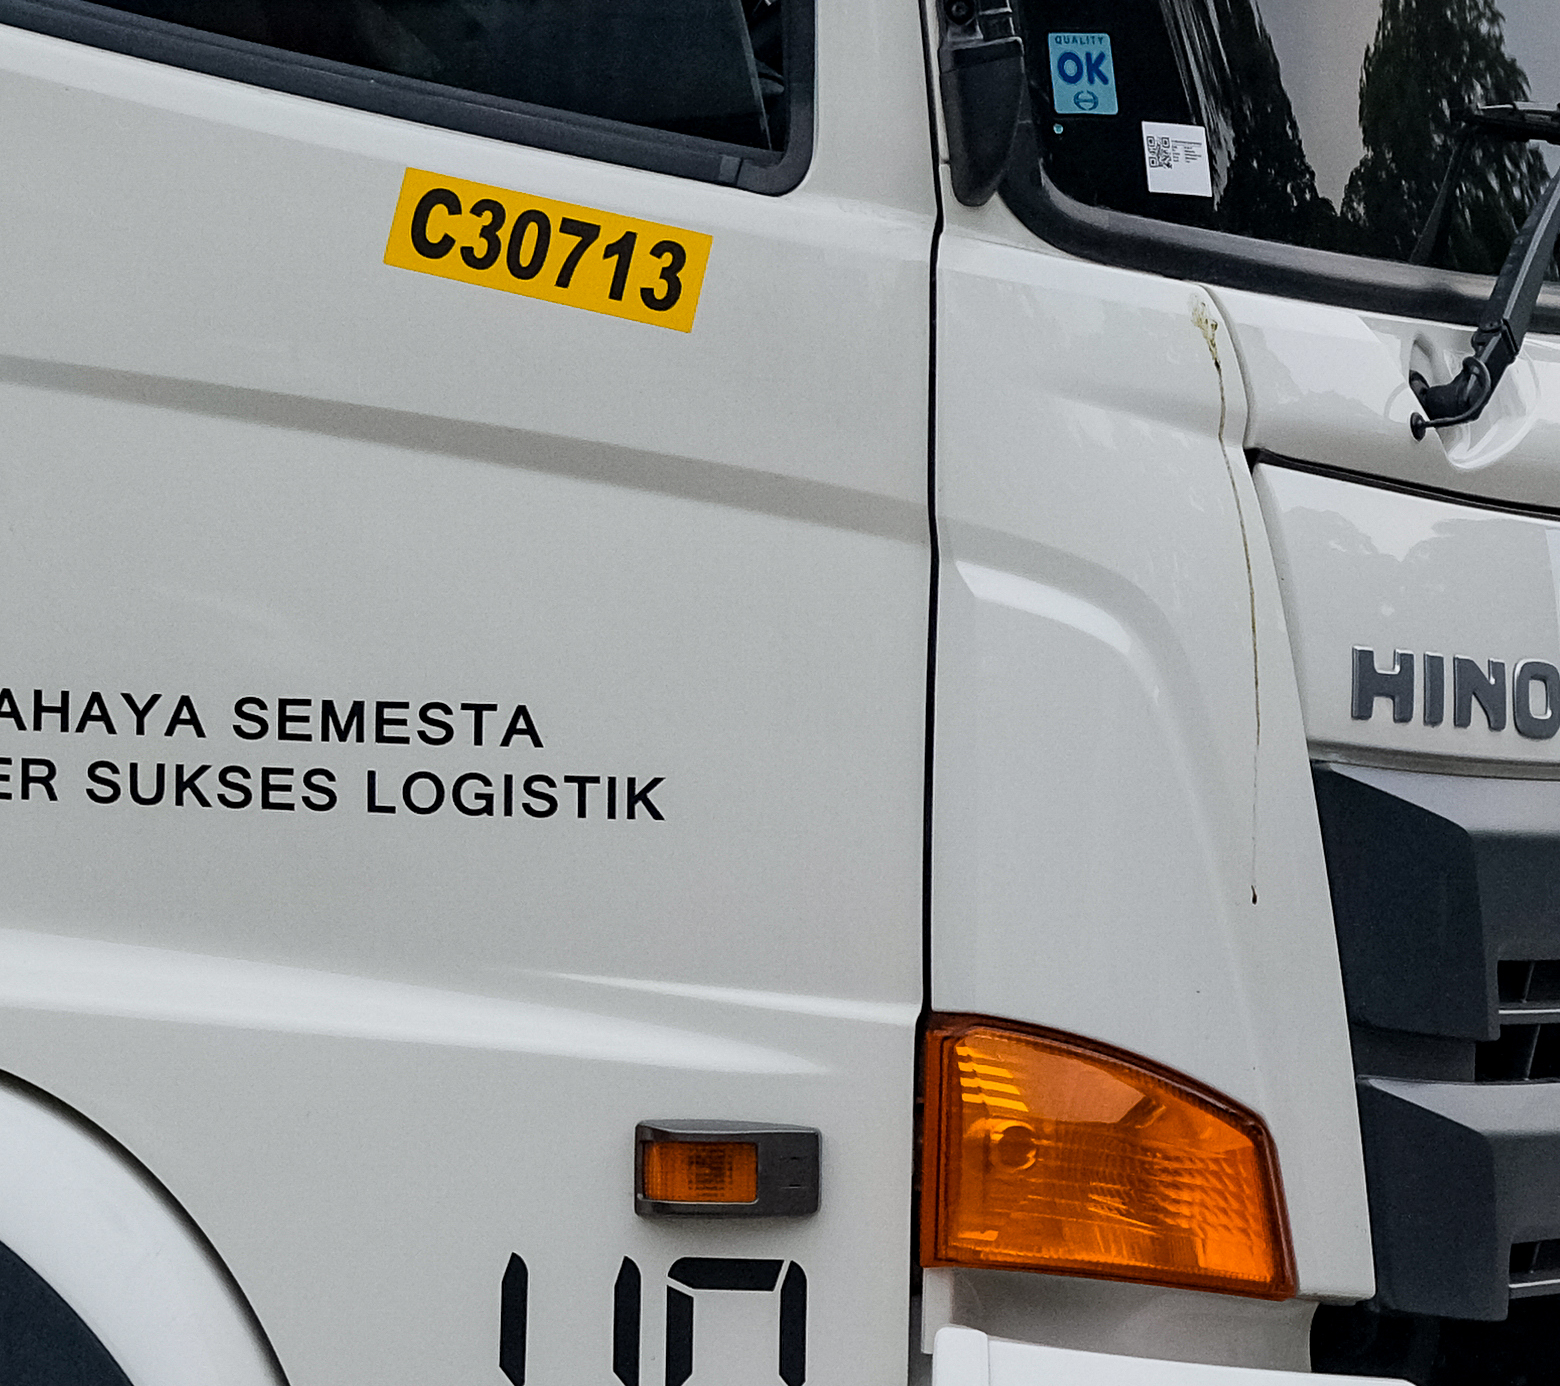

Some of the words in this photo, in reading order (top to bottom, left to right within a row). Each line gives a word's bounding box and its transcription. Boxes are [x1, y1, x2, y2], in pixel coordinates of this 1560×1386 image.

[1055, 35, 1103, 45] QUALITY
[1057, 51, 1109, 85] OK
[411, 188, 686, 311] C30713
[233, 697, 543, 748] SEMESTA
[86, 761, 338, 812] SUKSES
[368, 770, 666, 821] LOGISTIK
